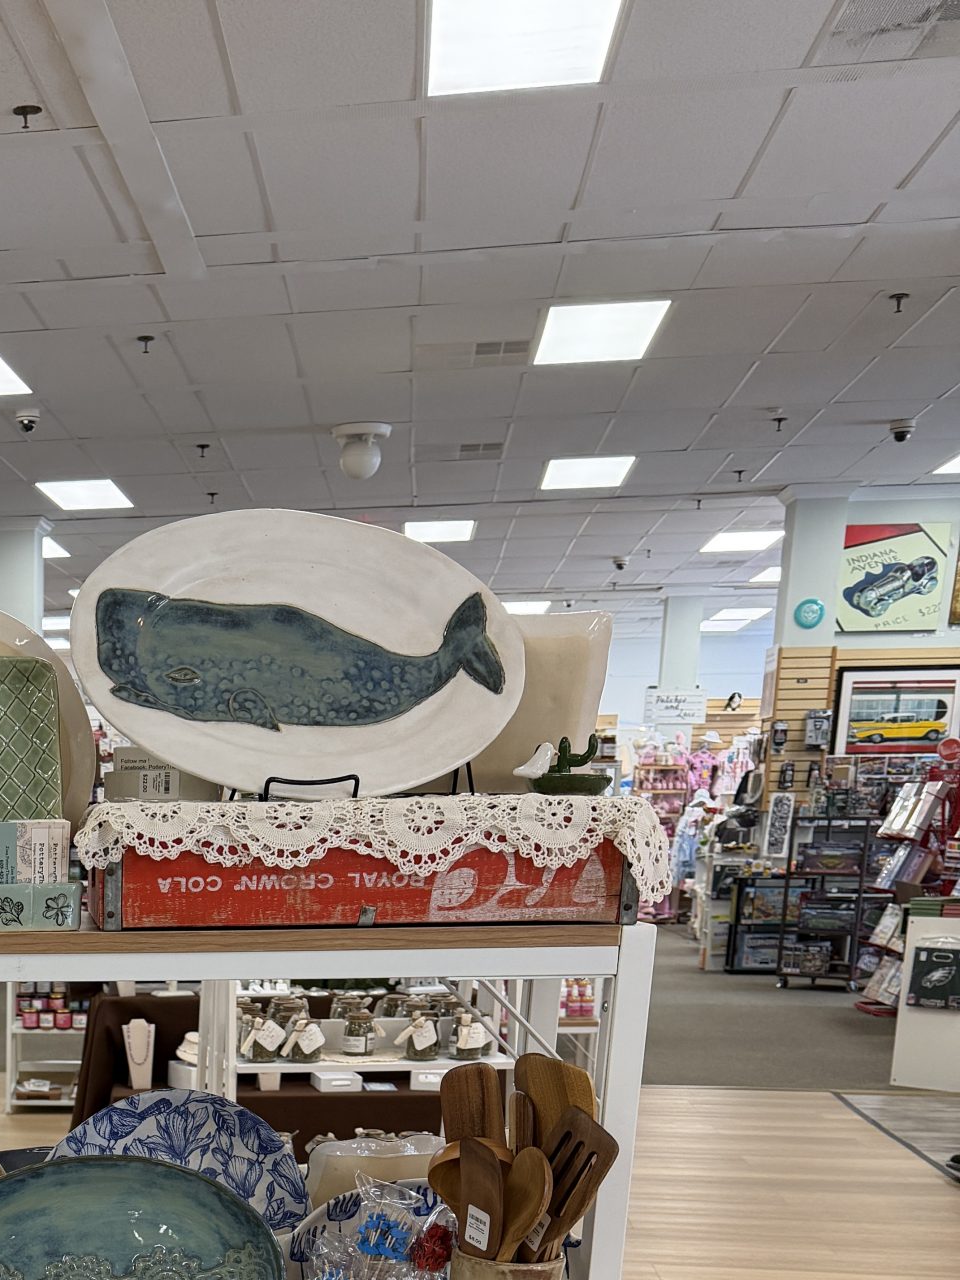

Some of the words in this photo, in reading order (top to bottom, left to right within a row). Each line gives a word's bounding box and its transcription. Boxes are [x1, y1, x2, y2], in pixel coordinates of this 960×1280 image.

[846, 548, 898, 566] INDIANA
[850, 555, 901, 574] AVENUE
[157, 875, 223, 894] COLA
[348, 870, 427, 890] ROYAL
